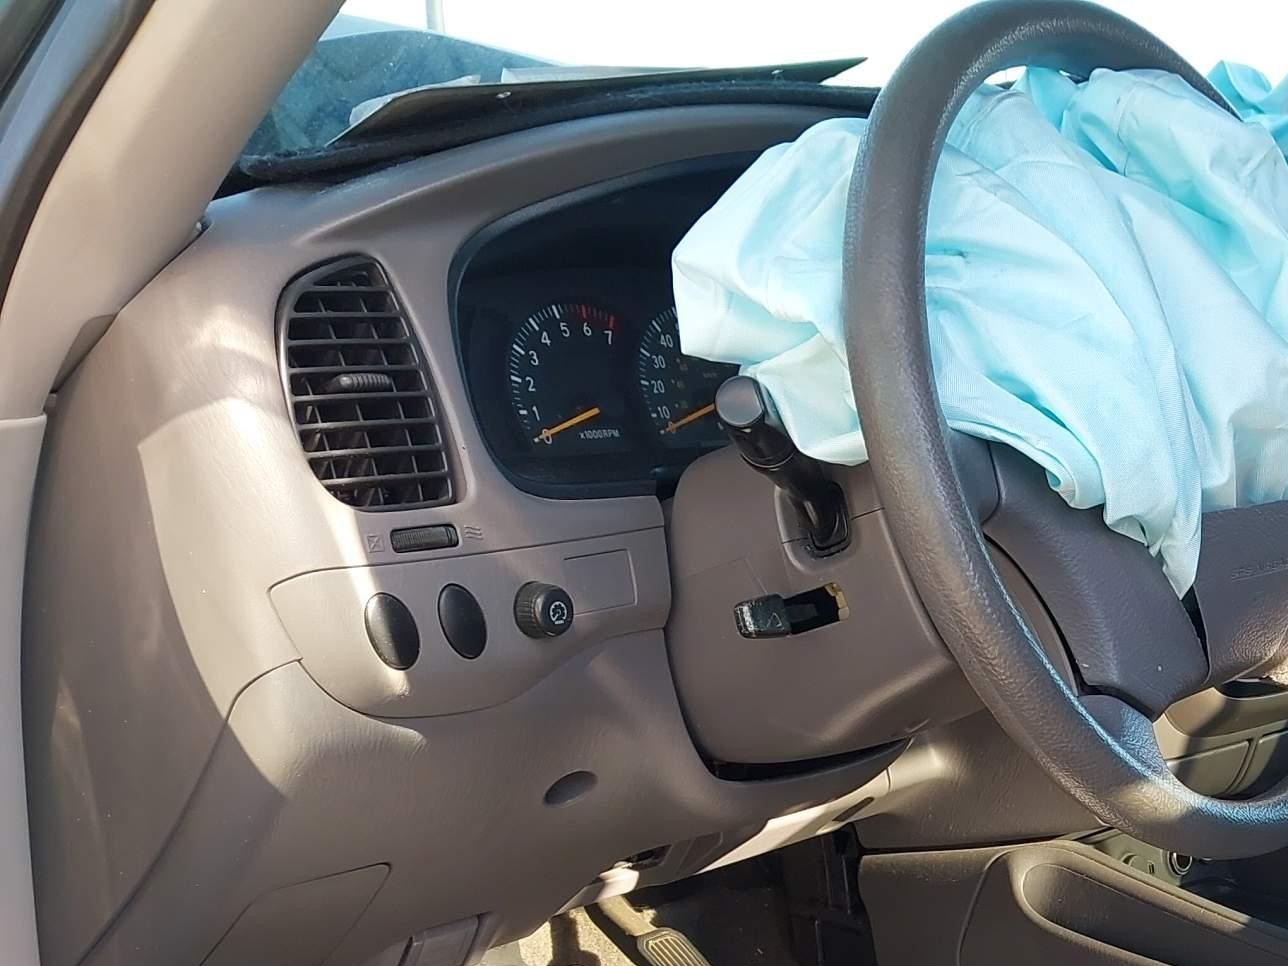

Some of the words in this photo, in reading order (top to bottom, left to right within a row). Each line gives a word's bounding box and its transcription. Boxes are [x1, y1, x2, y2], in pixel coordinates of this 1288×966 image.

[559, 321, 571, 338] 5
[582, 321, 593, 337] 6
[602, 329, 613, 346] 7
[540, 330, 552, 348] 4
[660, 333, 674, 349] 40
[528, 350, 540, 367] 3
[651, 354, 667, 370] 30
[525, 375, 537, 393] 2
[651, 379, 666, 395] 20
[531, 404, 542, 423] 1
[656, 404, 672, 420] 10
